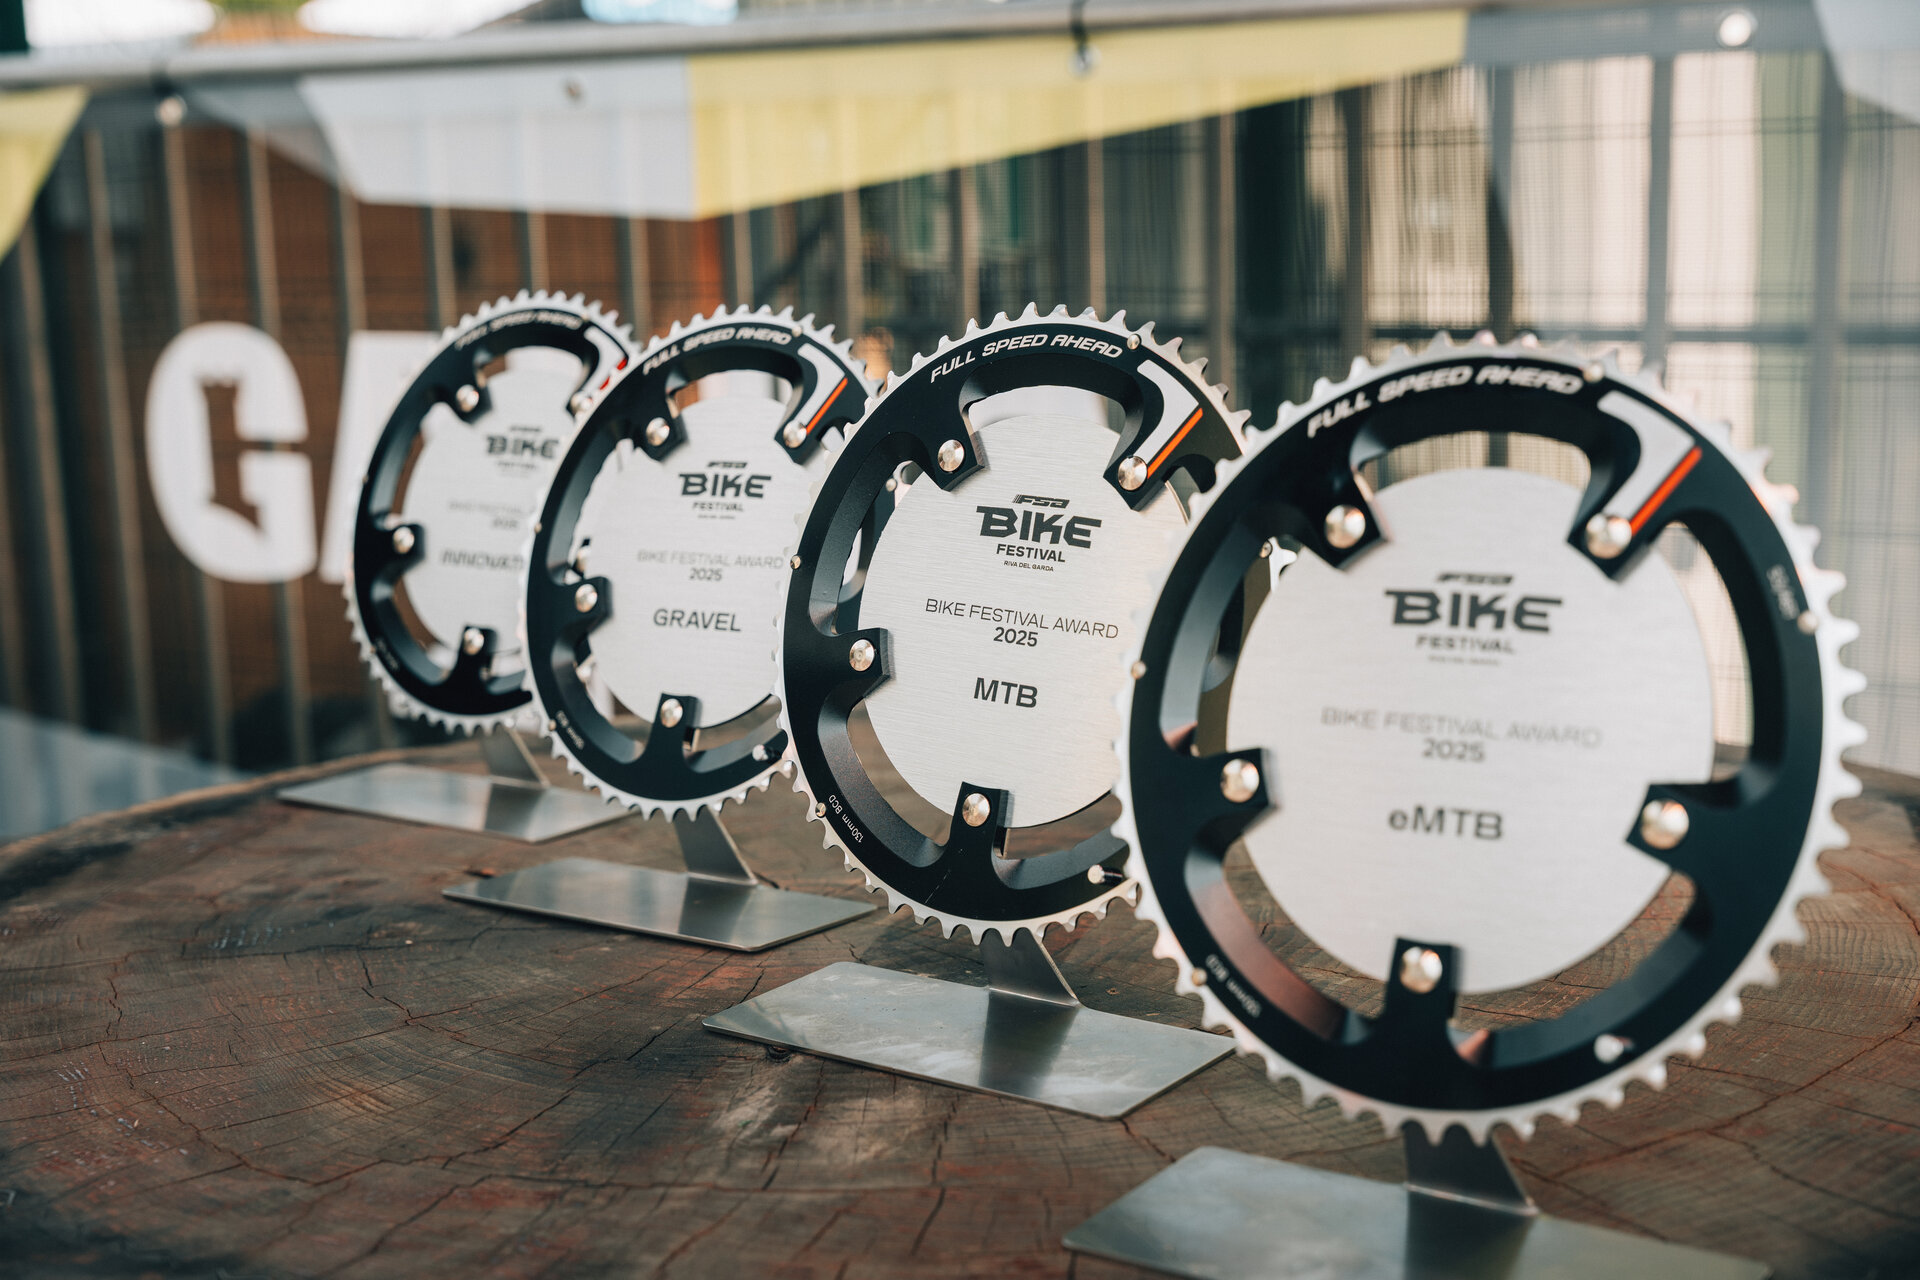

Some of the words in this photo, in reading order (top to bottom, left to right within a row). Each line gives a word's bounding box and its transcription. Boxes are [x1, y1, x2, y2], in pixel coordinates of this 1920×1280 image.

[642, 344, 680, 376] FULL
[682, 326, 736, 352] SPEED
[735, 327, 792, 345] AHEAD
[930, 351, 976, 383] FULL
[981, 333, 1049, 358] SPEED
[1050, 333, 1123, 359] AHEAD
[1307, 391, 1372, 439] FULL
[1377, 365, 1474, 403] SPEED
[1475, 365, 1584, 395] AHEAD
[679, 473, 772, 498] BIKE
[976, 505, 1102, 549] BIKE
[996, 543, 1066, 562] FESTIVAL
[1003, 560, 1018, 568] RIVA
[1031, 564, 1054, 572] GARDA
[688, 567, 723, 581] 2025
[652, 608, 742, 632] GRAVEL
[925, 598, 966, 617] BIKE
[969, 604, 1049, 629] FESTIVAL
[1053, 617, 1119, 639] AWARD
[1384, 589, 1563, 633] BIKE
[993, 626, 1038, 647] 2025
[1415, 634, 1516, 655] FESTIVAL
[973, 677, 1038, 708] MTB
[1320, 705, 1377, 730] BIKE
[1381, 710, 1500, 741] FESTIVAL
[1504, 719, 1605, 749] AWARD
[1421, 737, 1486, 763] 2025
[828, 794, 843, 815] BCD
[841, 813, 864, 843] 130mm
[1388, 804, 1505, 841] eMTB
